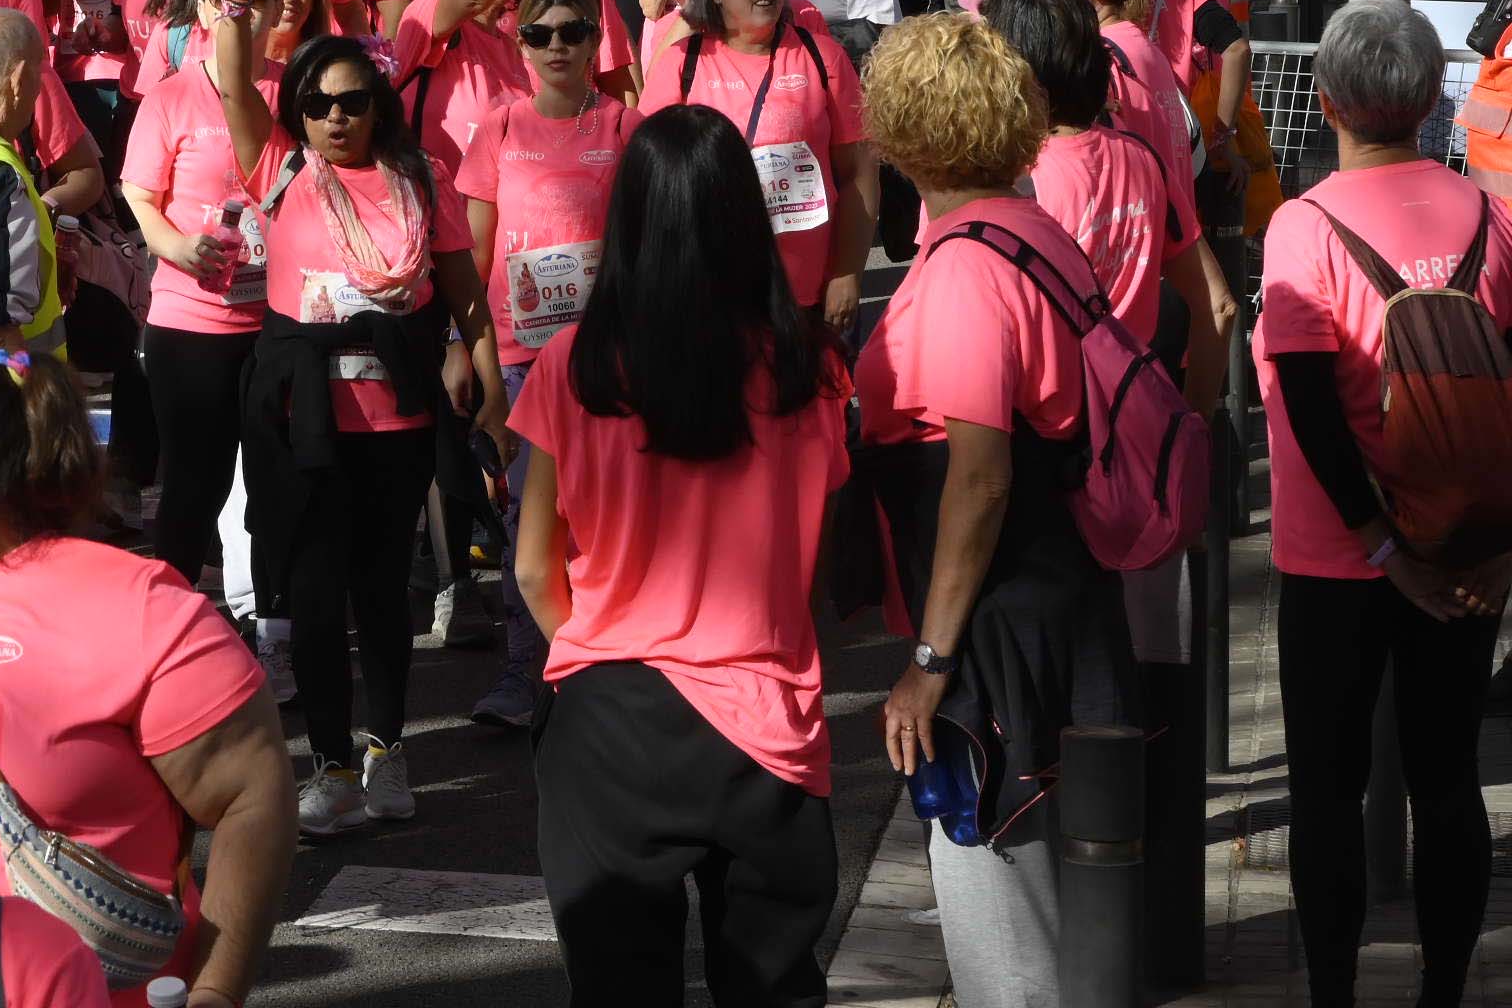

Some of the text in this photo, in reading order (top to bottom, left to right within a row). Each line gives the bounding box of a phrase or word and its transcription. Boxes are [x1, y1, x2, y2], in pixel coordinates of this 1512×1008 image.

[537, 261, 576, 274] ASTURIANA
[542, 282, 578, 300] 016
[548, 301, 575, 313] 10060
